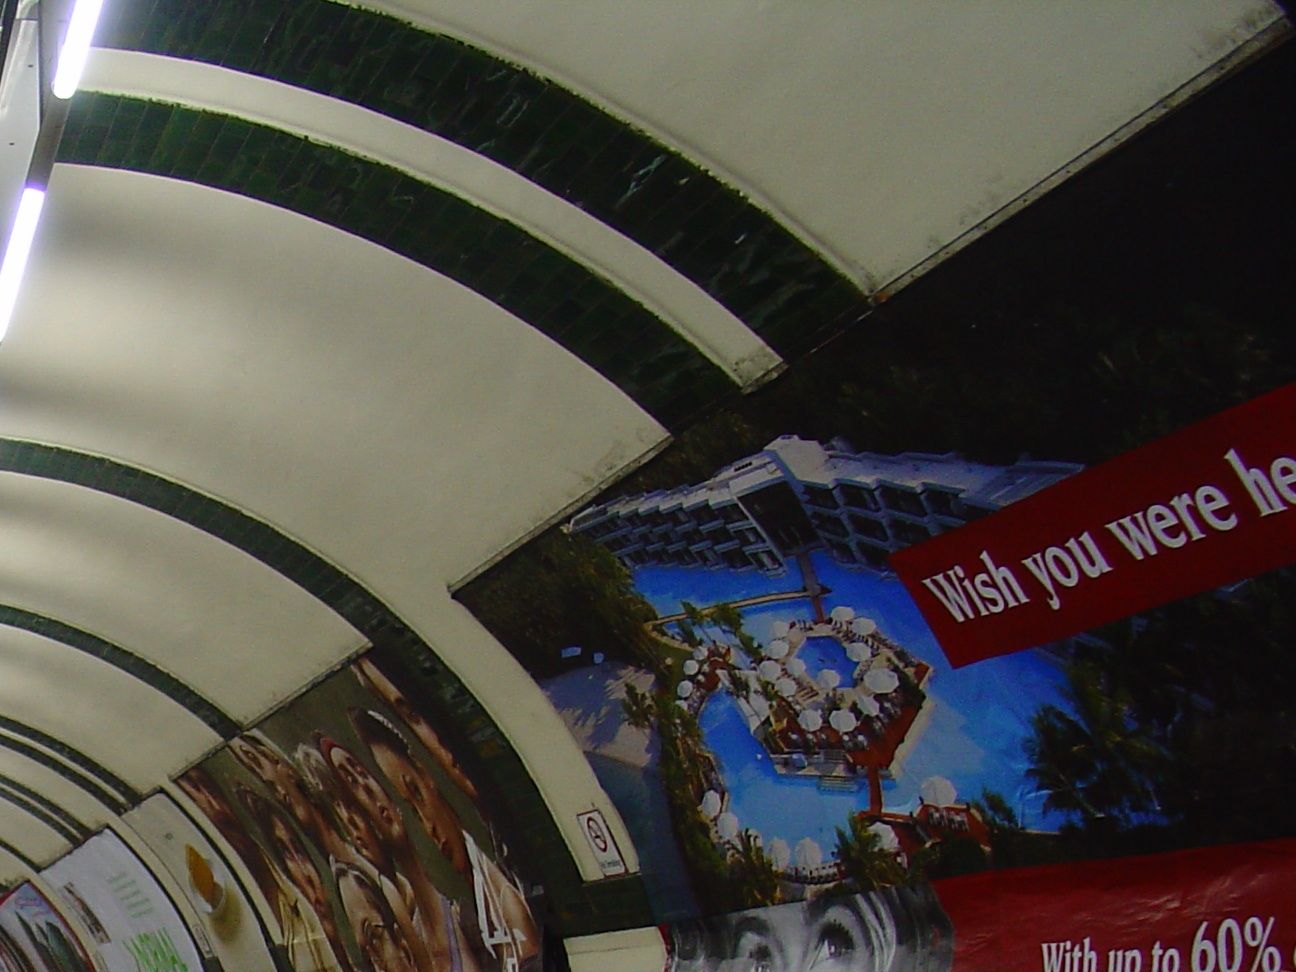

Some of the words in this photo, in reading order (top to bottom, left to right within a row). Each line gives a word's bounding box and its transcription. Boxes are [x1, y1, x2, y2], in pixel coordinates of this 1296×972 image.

[922, 550, 1031, 624] Wish
[1022, 531, 1114, 611] you
[1105, 484, 1238, 561] were
